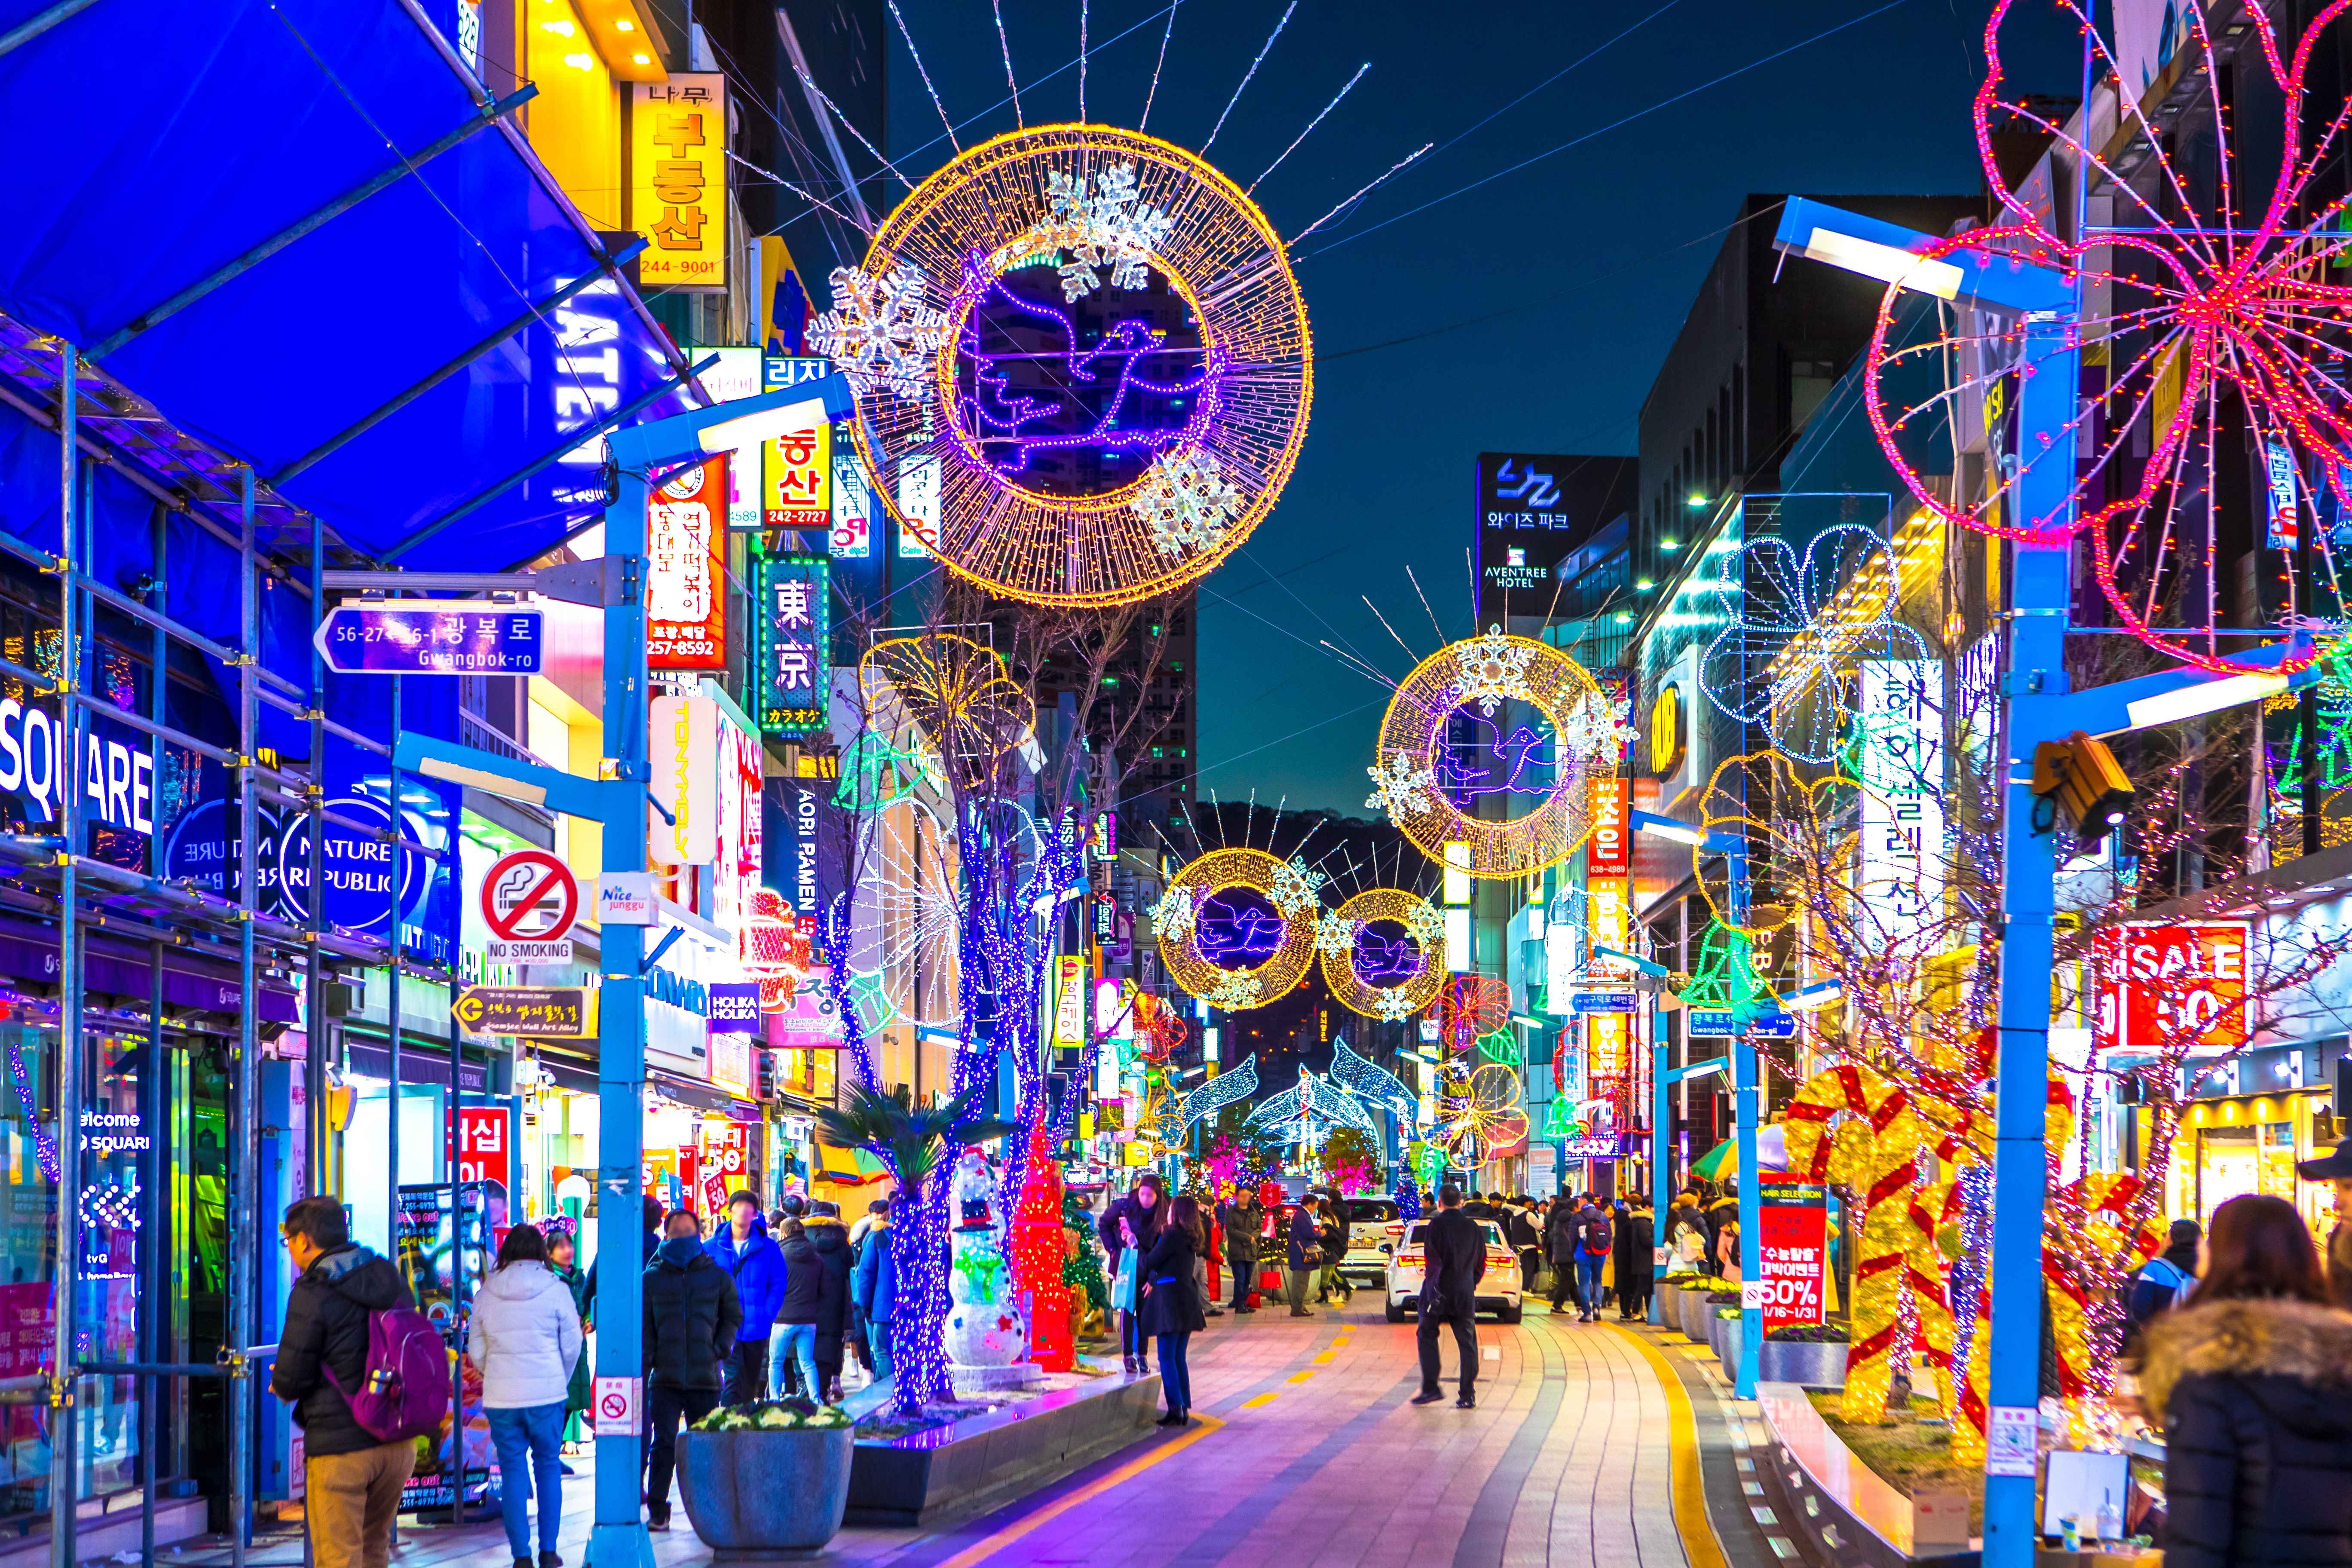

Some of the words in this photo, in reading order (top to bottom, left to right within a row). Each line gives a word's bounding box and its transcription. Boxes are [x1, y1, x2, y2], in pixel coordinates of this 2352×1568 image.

[648, 85, 714, 105] 나무
[652, 113, 708, 251] 부동산
[640, 260, 715, 274] 244-9001
[769, 359, 826, 386] 리치
[778, 430, 823, 507] 동산
[769, 510, 827, 523] 242-2727
[1487, 511, 1535, 530] 와이즈
[1538, 513, 1569, 530] 파크
[1485, 566, 1547, 578] AVENTREE
[1497, 578, 1534, 588] HOTEL
[336, 627, 383, 642] 56-27
[441, 617, 533, 645] 광복로
[653, 626, 706, 640] 포장.배달
[774, 579, 814, 690] 東京
[646, 640, 714, 655] 257-8592
[419, 650, 532, 669] Gwangbok-ro
[768, 709, 821, 724] カラオケ
[675, 701, 689, 859] TONYMOLY
[798, 788, 816, 836] AORI
[1060, 805, 1075, 867] MISSA
[798, 841, 816, 911] RAMEN
[602, 889, 632, 901] Nice
[609, 901, 644, 911] junggu
[1102, 902, 1113, 934] Taurus
[490, 944, 506, 957] NO
[511, 943, 569, 957] SMOKING
[2132, 944, 2242, 979] SALE
[712, 997, 757, 1009] HOLIKA
[2156, 990, 2219, 1033] 50
[712, 1008, 758, 1020] HOLIKA
[1060, 981, 1078, 1043] 망고케이스
[558, 1024, 579, 1033] Alley
[80, 1112, 140, 1127] elcome
[711, 1186, 726, 1211] 50
[1760, 1189, 1779, 1197] HAIR
[1780, 1189, 1822, 1199] SELECTION
[423, 1211, 439, 1223] out
[86, 1253, 108, 1264] tvG
[1762, 1279, 1817, 1306] 50%
